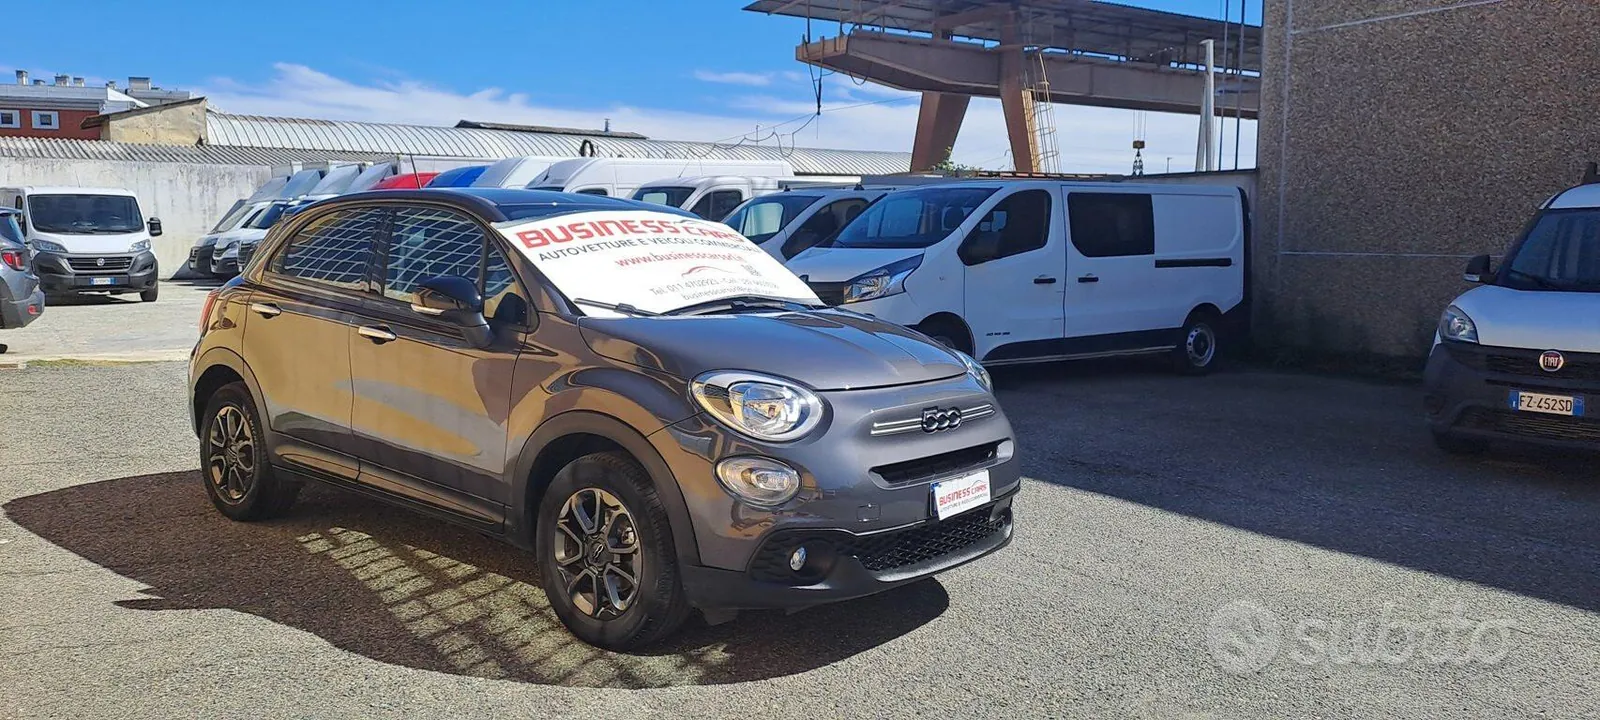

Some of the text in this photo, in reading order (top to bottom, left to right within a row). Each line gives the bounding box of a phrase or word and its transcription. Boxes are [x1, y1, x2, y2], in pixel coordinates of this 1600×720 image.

[516, 219, 746, 249] BUSINESS CARS
[538, 238, 636, 261] AUTOVETTURE
[638, 238, 649, 246] E
[647, 237, 694, 246] VEICOLI
[1544, 356, 1559, 367] FIAT
[922, 405, 962, 434] 500
[939, 486, 971, 506] BUSINESS
[971, 483, 987, 495] CARS
